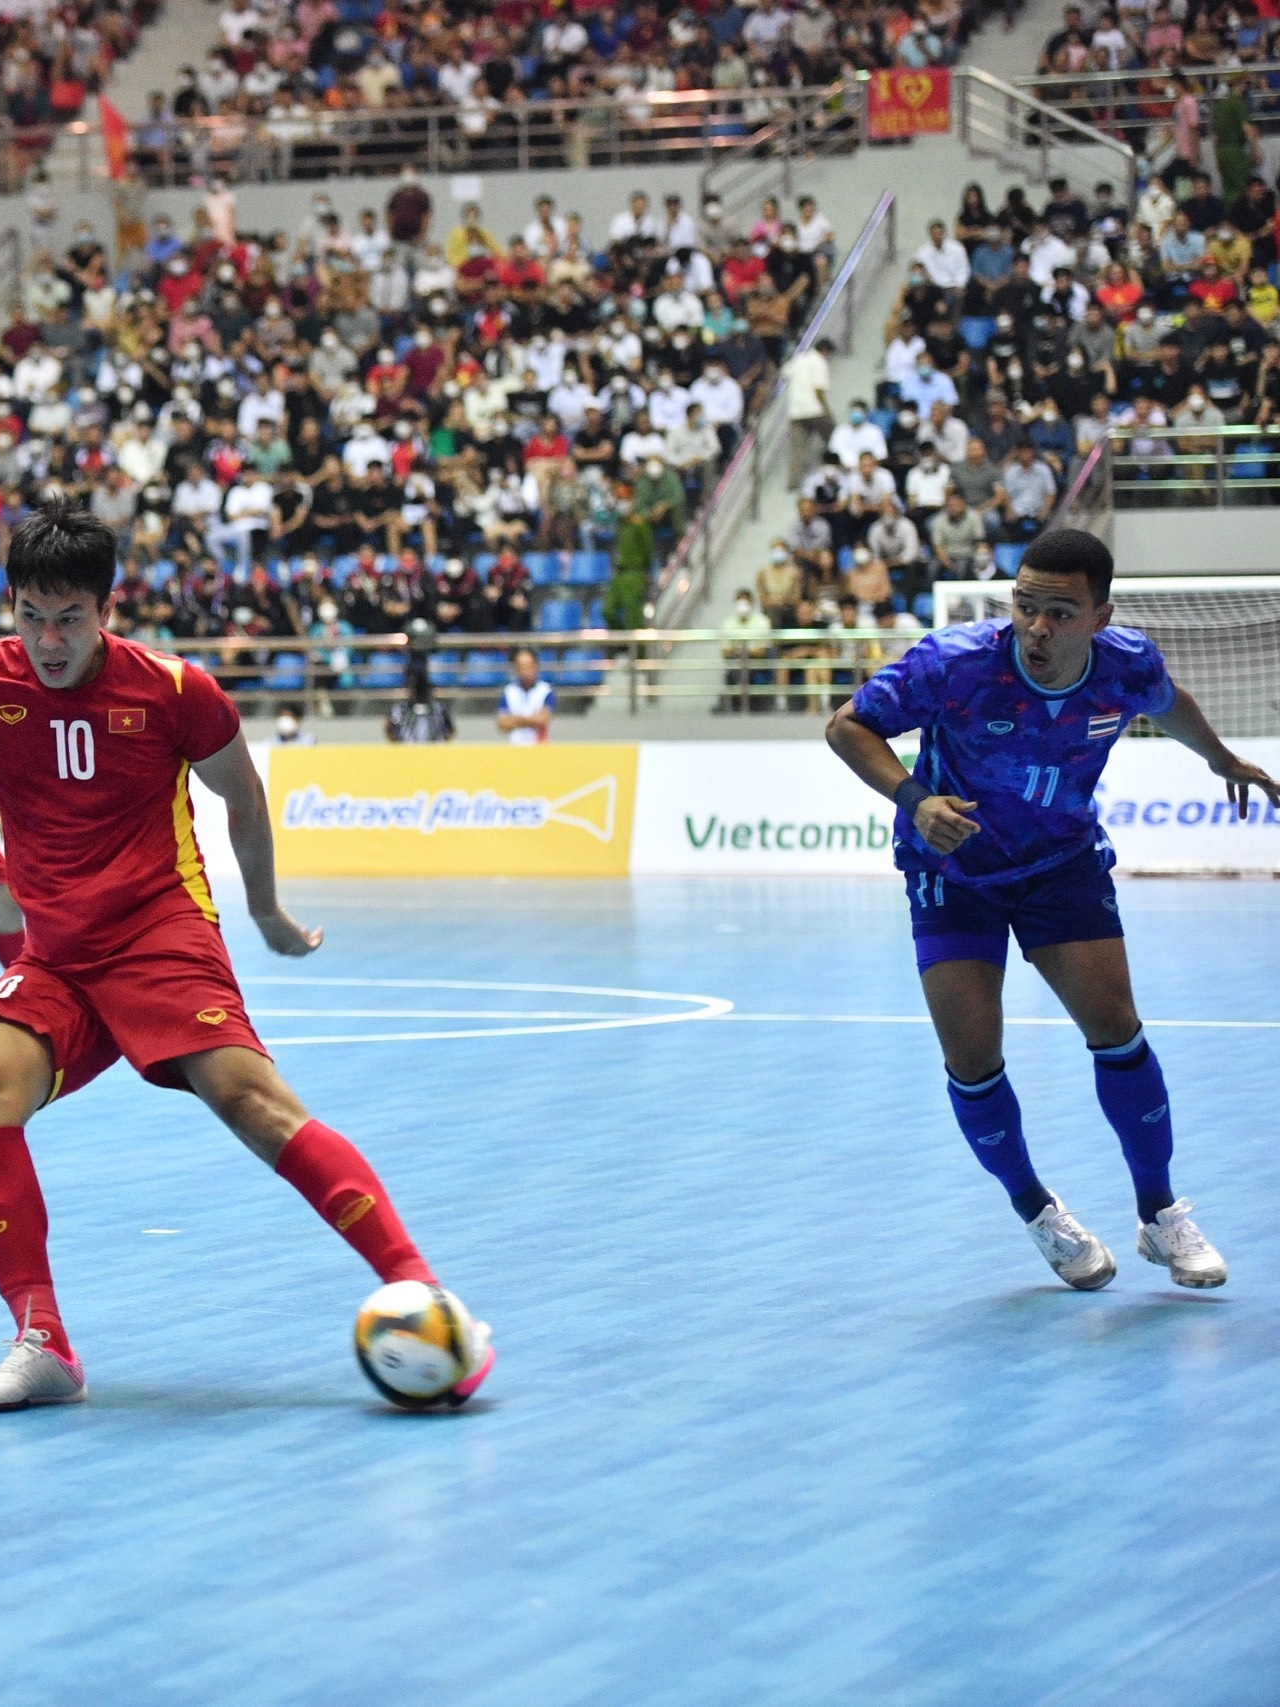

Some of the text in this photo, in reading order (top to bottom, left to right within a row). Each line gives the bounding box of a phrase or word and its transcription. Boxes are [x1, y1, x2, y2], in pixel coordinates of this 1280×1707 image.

[49, 719, 95, 780] 10
[1023, 765, 1060, 807] 11
[283, 788, 546, 831] Vietravel Airlines
[684, 814, 890, 850] Vietcomb
